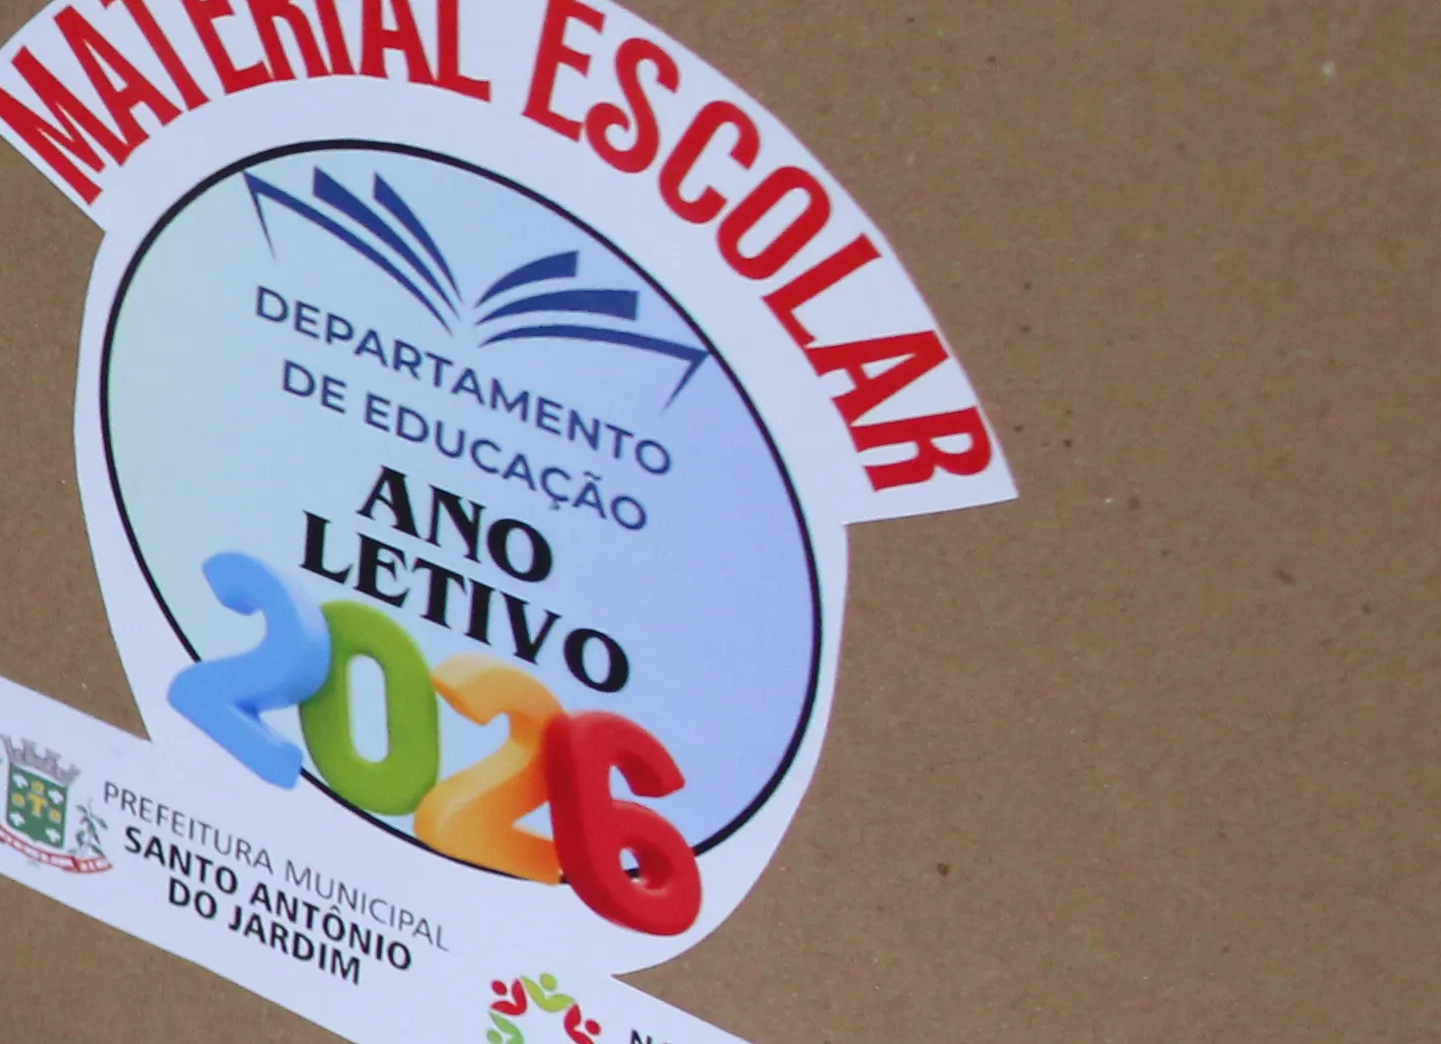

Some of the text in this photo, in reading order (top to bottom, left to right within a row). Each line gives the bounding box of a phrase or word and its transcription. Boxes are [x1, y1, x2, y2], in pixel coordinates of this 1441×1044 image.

[522, 0, 993, 493] ESCOLAR
[256, 285, 671, 476] DEPARTAMENTO
[282, 359, 647, 531] DE EDUCAÇÃO
[299, 510, 629, 693] LETIVO
[357, 465, 554, 582] ANO
[166, 550, 702, 936] 2026
[104, 781, 274, 875] PREFEITURA
[285, 859, 450, 952] MUNICIPAL
[124, 826, 238, 894] SANTO
[250, 882, 412, 971] ANTÔNIO
[168, 877, 361, 985] DO JARDIM
